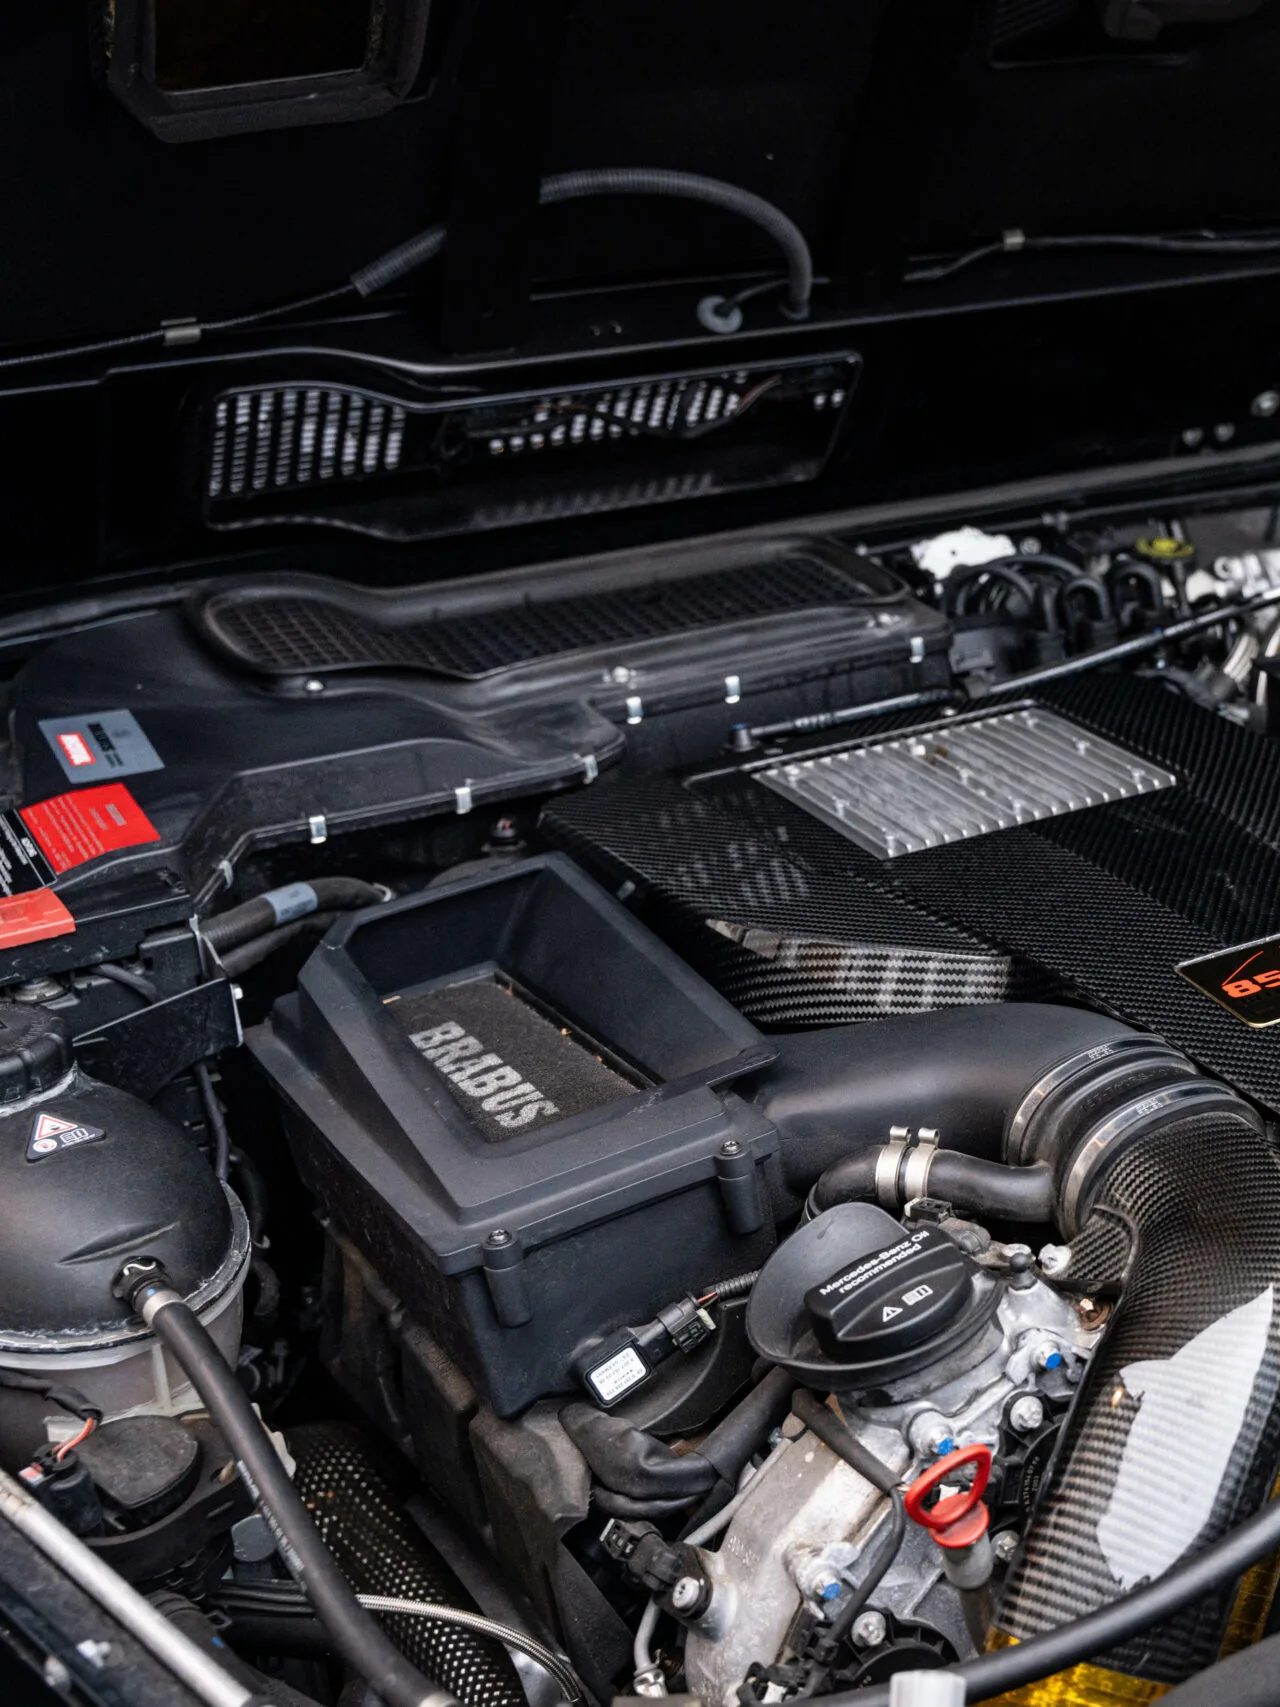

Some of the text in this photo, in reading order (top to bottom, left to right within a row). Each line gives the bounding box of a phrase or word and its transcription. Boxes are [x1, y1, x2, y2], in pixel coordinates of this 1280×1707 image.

[408, 1021, 560, 1128] BRABUS
[819, 1230, 930, 1295] Mercedes-Benz Oil
[839, 1243, 922, 1294] recommended
